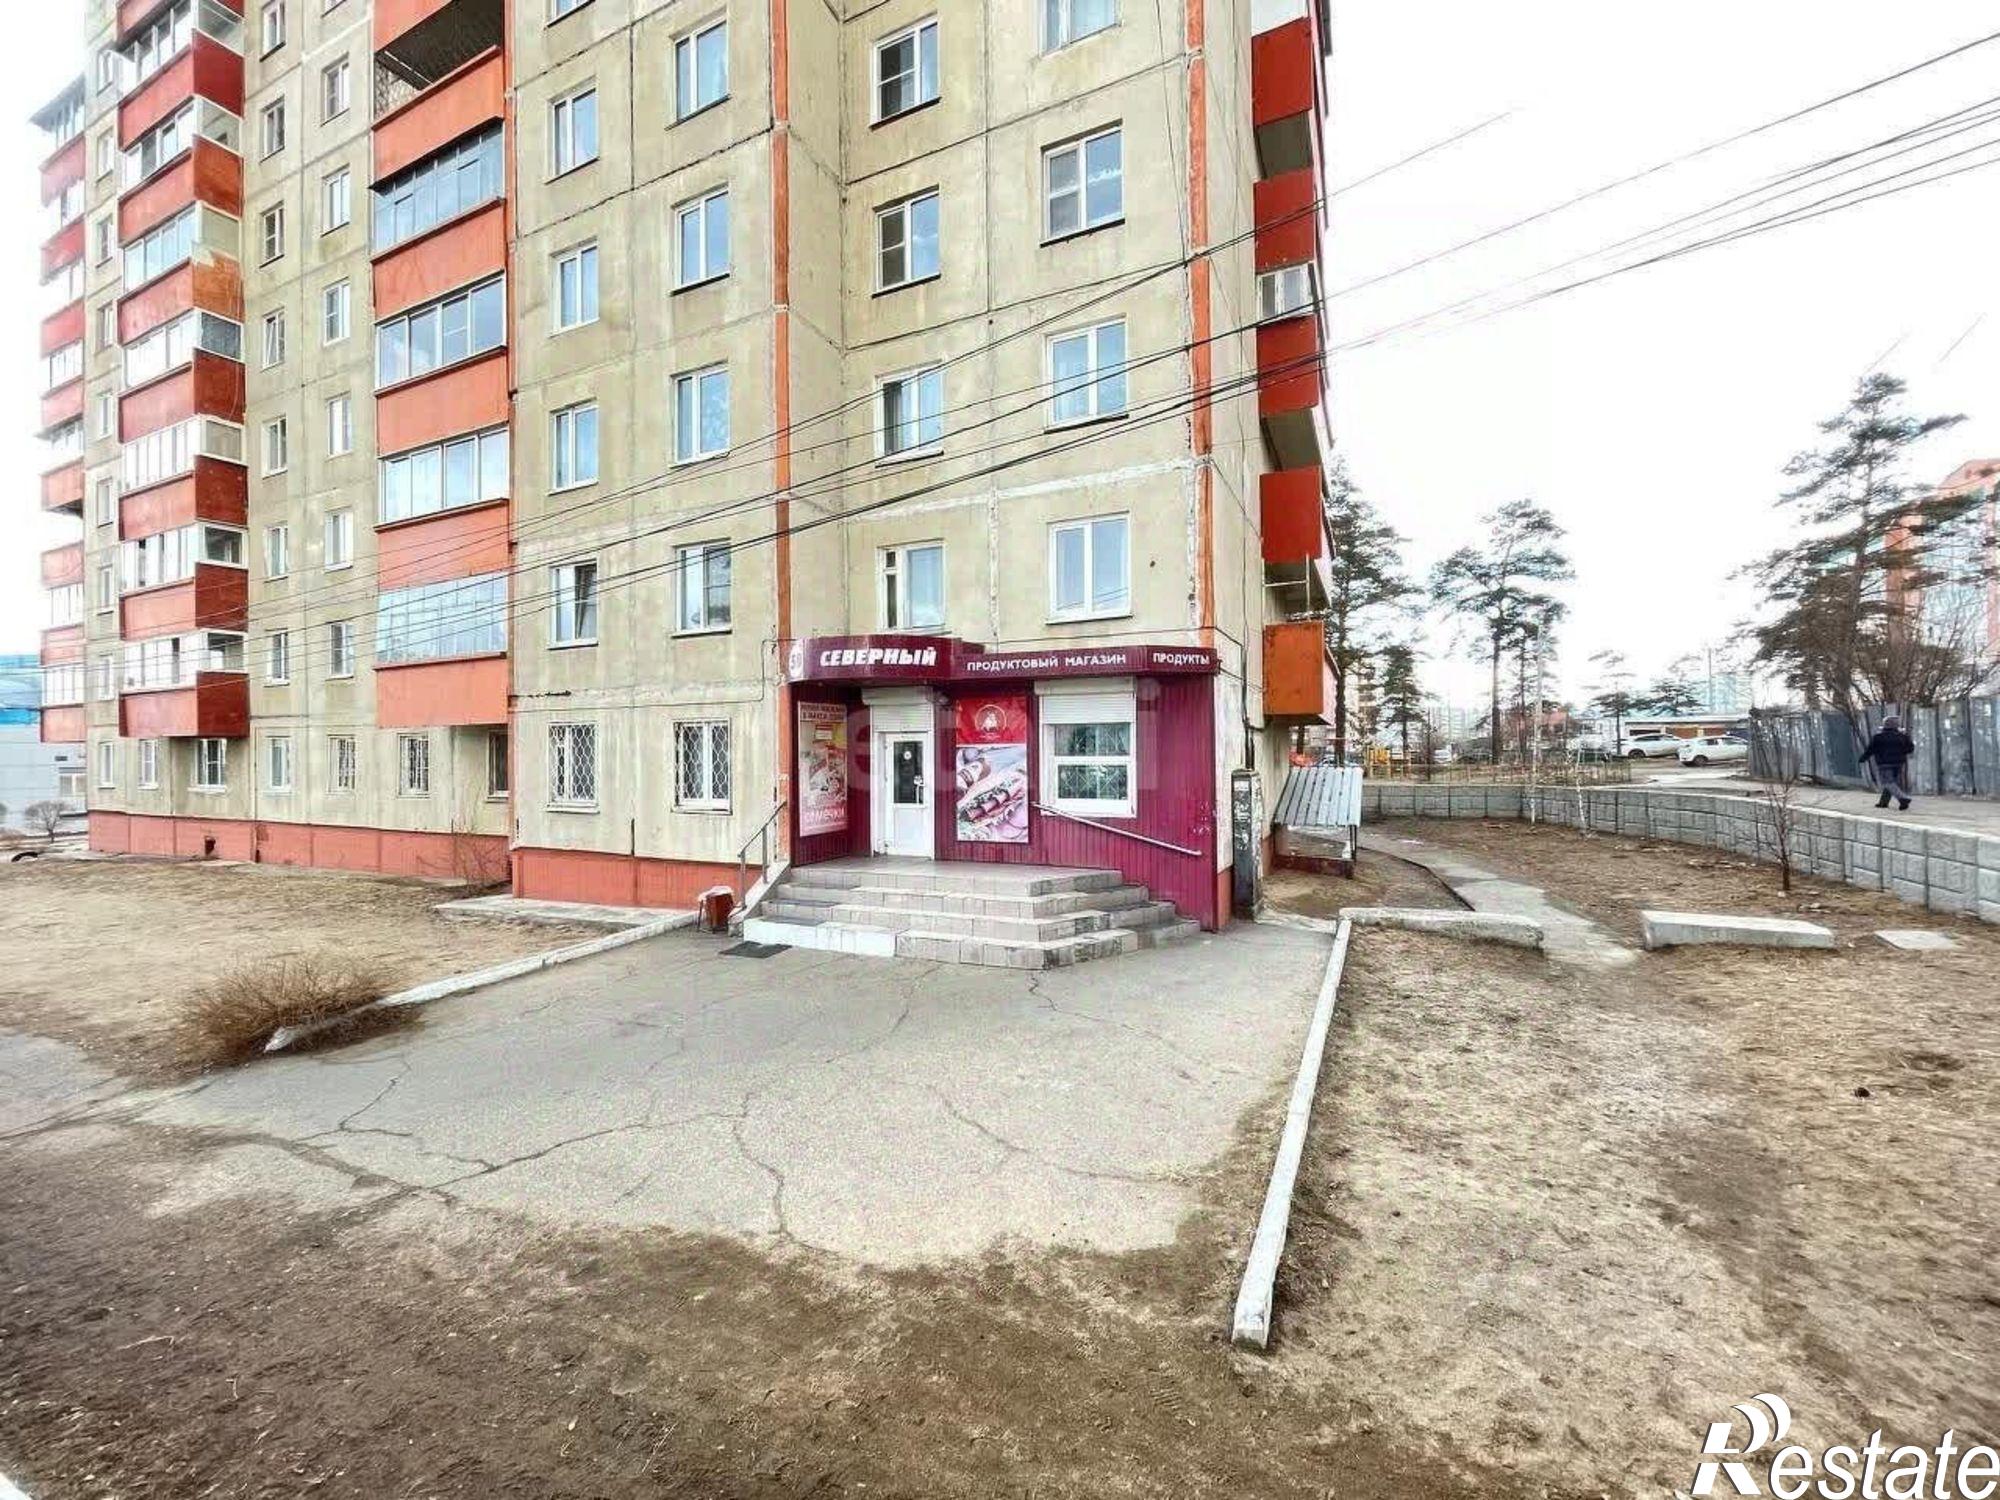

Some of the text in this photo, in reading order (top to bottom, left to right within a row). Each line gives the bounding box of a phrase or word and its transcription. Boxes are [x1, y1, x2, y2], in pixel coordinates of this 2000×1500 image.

[820, 646, 937, 667] СЕВЕРНЫЙ
[966, 654, 1127, 673] ПРОДУКТОВЫЙ МАГАЗИН
[1153, 652, 1210, 666] ПРОДУКТЫ
